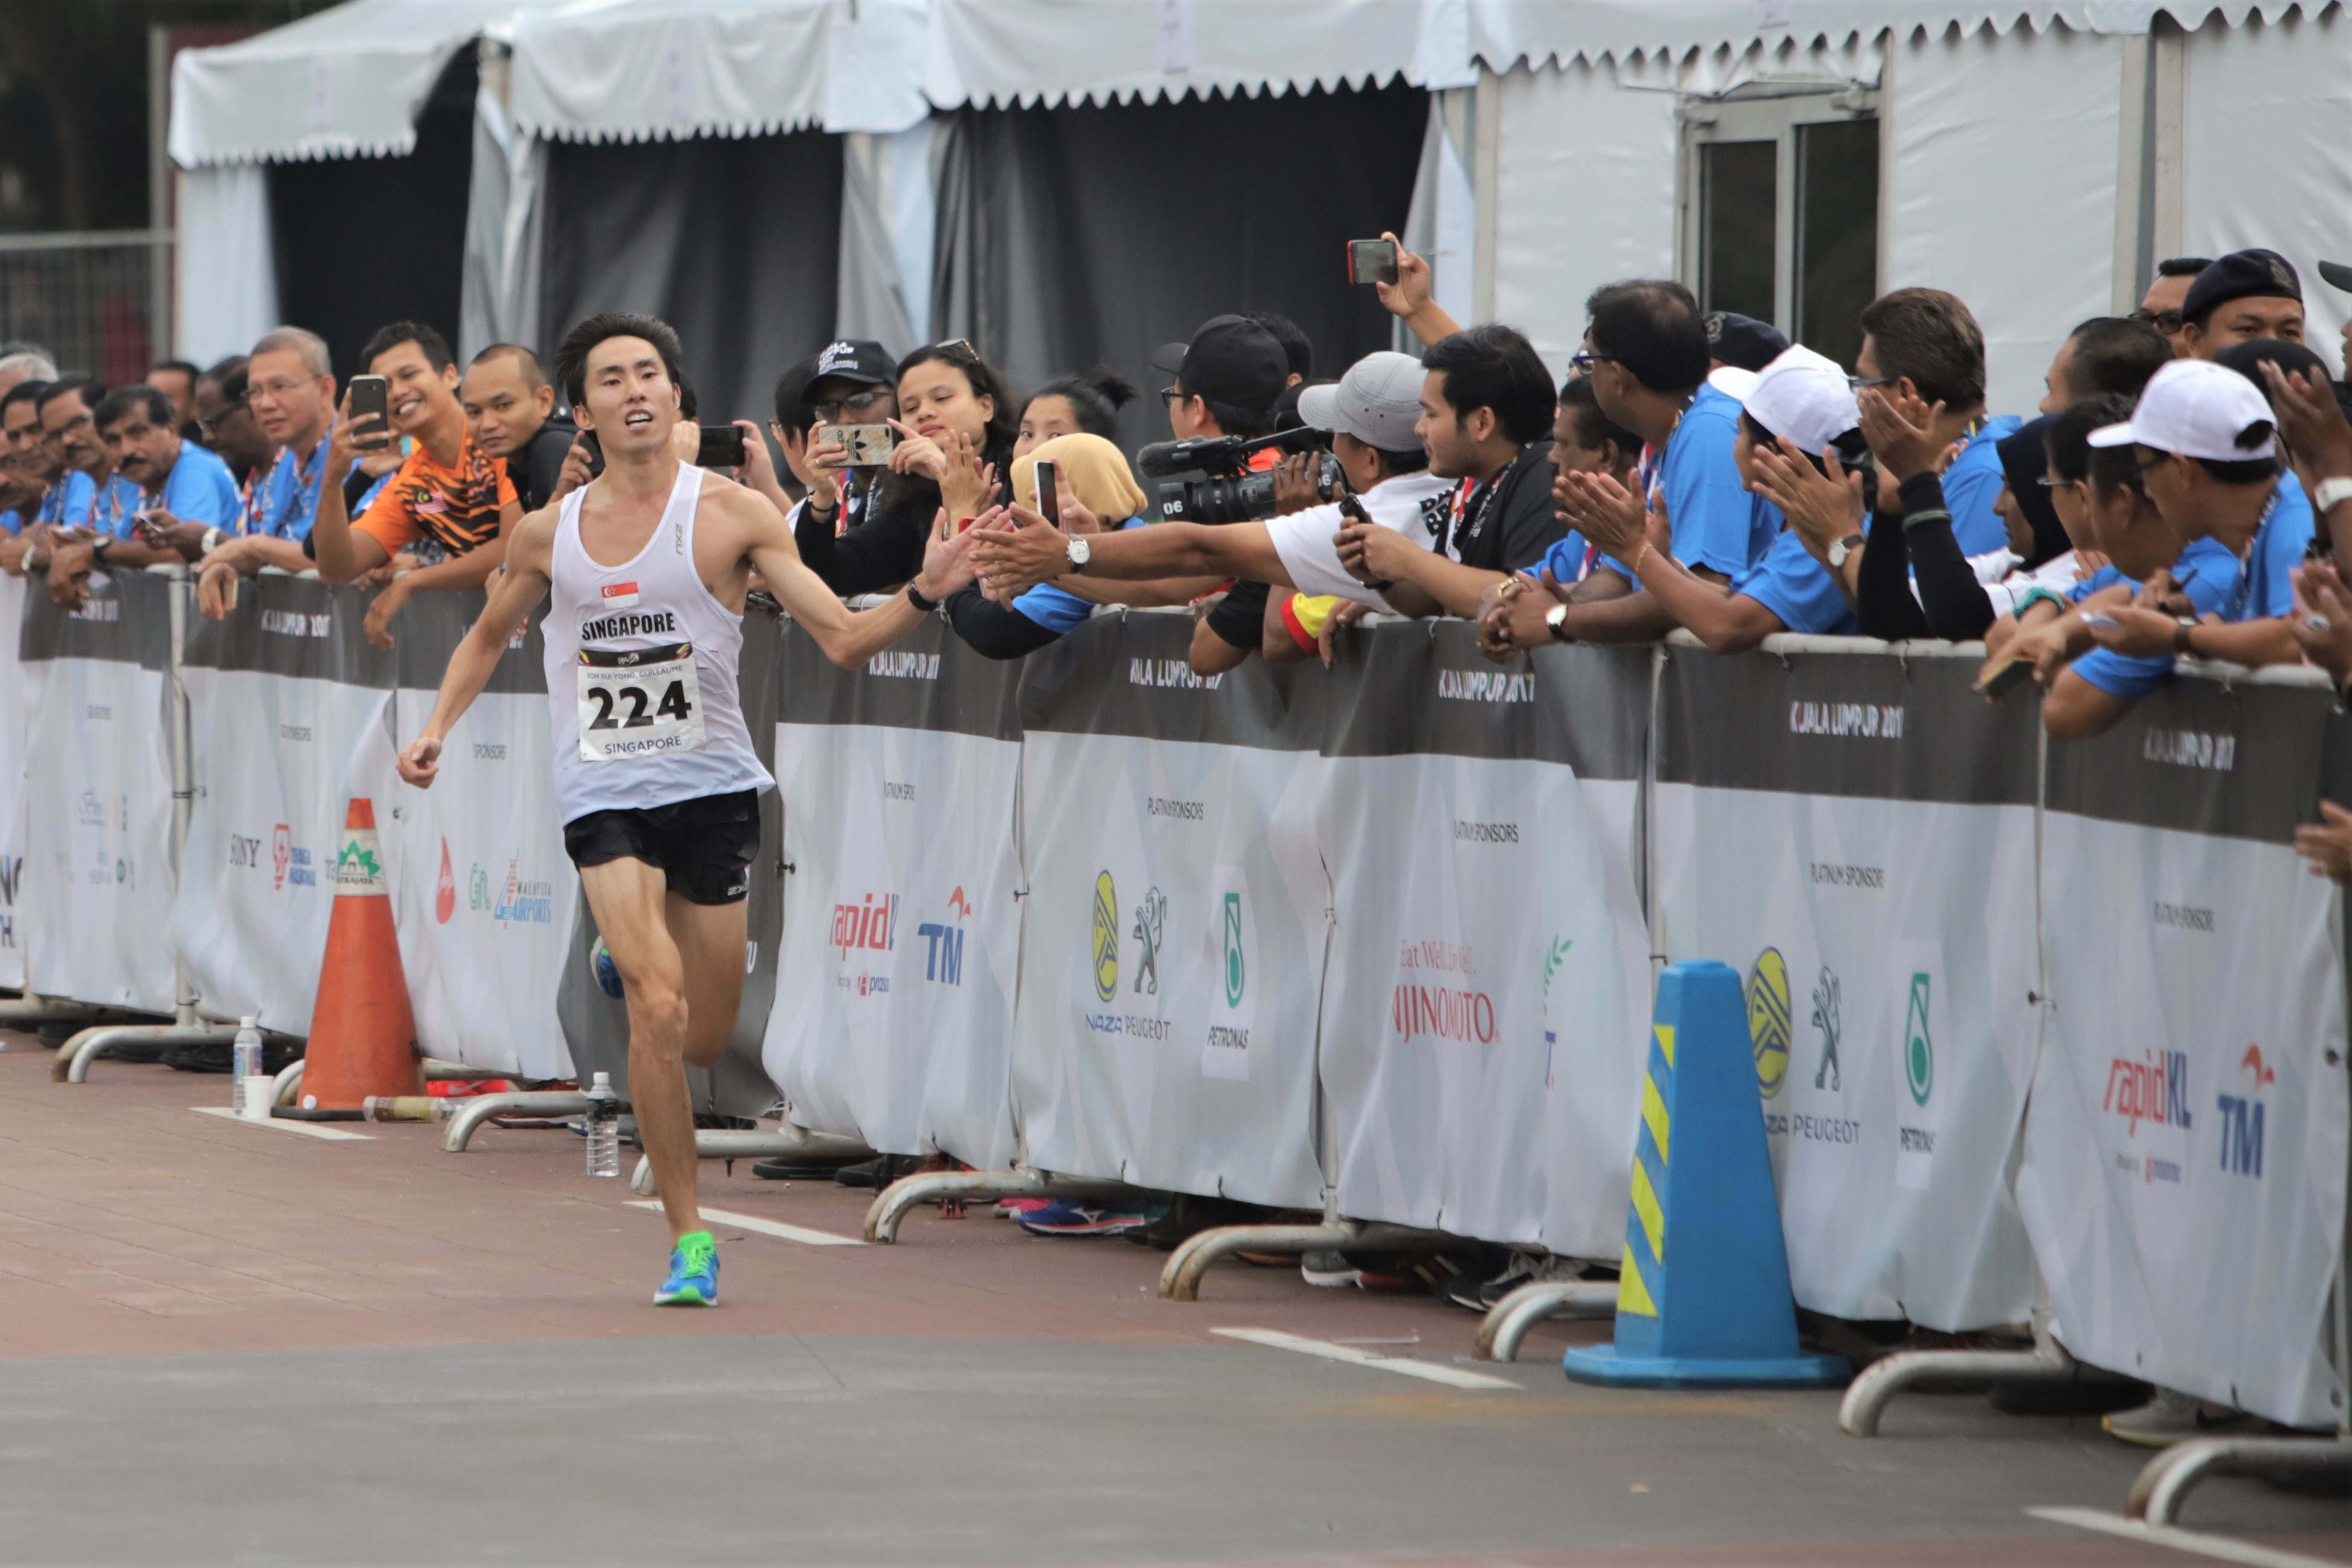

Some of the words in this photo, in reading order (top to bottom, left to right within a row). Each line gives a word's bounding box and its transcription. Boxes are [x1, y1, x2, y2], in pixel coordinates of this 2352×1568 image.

[1163, 501, 1183, 515] 06
[582, 613, 675, 641] SINGAPORE
[639, 665, 683, 678] GUILLAUME
[588, 680, 692, 730] 224
[605, 736, 682, 754] SINGAPORE
[917, 923, 964, 987] TM
[1085, 1014, 1123, 1035] NAZA
[1125, 1015, 1171, 1041] PEUGEOT
[1207, 1026, 1249, 1050] PETRONAS
[2103, 1047, 2191, 1139] rapidKL
[1793, 1115, 1860, 1145] PEUGEOT
[2217, 1094, 2265, 1179] TM
